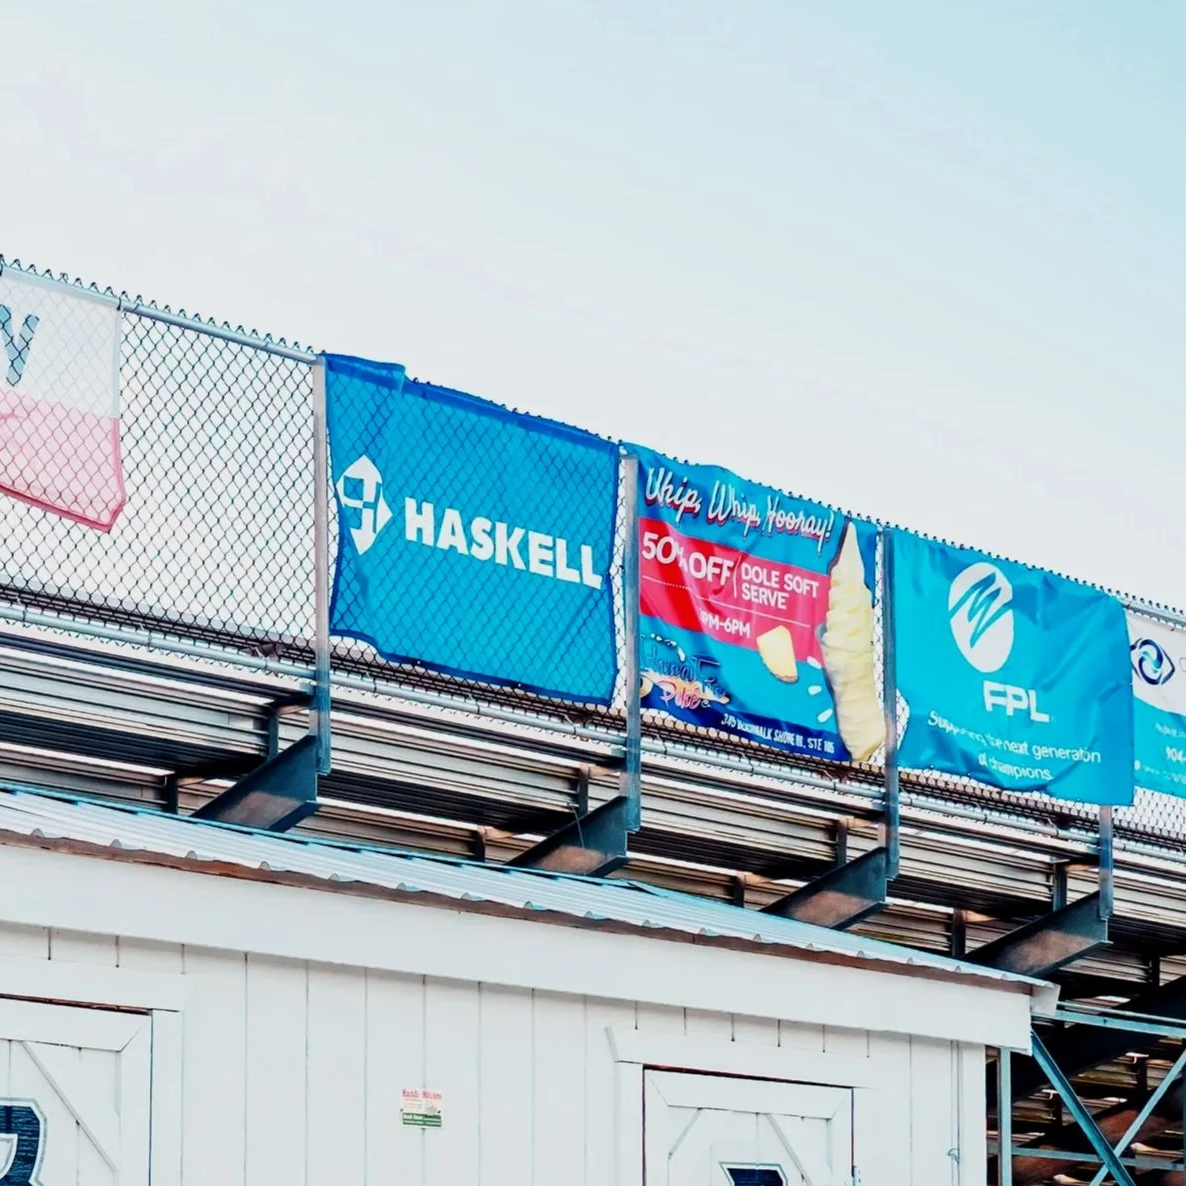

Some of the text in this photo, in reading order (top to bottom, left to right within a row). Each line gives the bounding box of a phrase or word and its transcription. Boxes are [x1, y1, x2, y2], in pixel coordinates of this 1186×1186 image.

[762, 494, 835, 554] Hooray!
[404, 496, 604, 590] HASKELL
[688, 551, 734, 586] OFF
[740, 562, 820, 598] DOLE SOFT
[741, 583, 790, 610] SERVE
[983, 680, 1050, 723] FPL
[807, 738, 823, 751] STE
[1003, 740, 1030, 756] next
